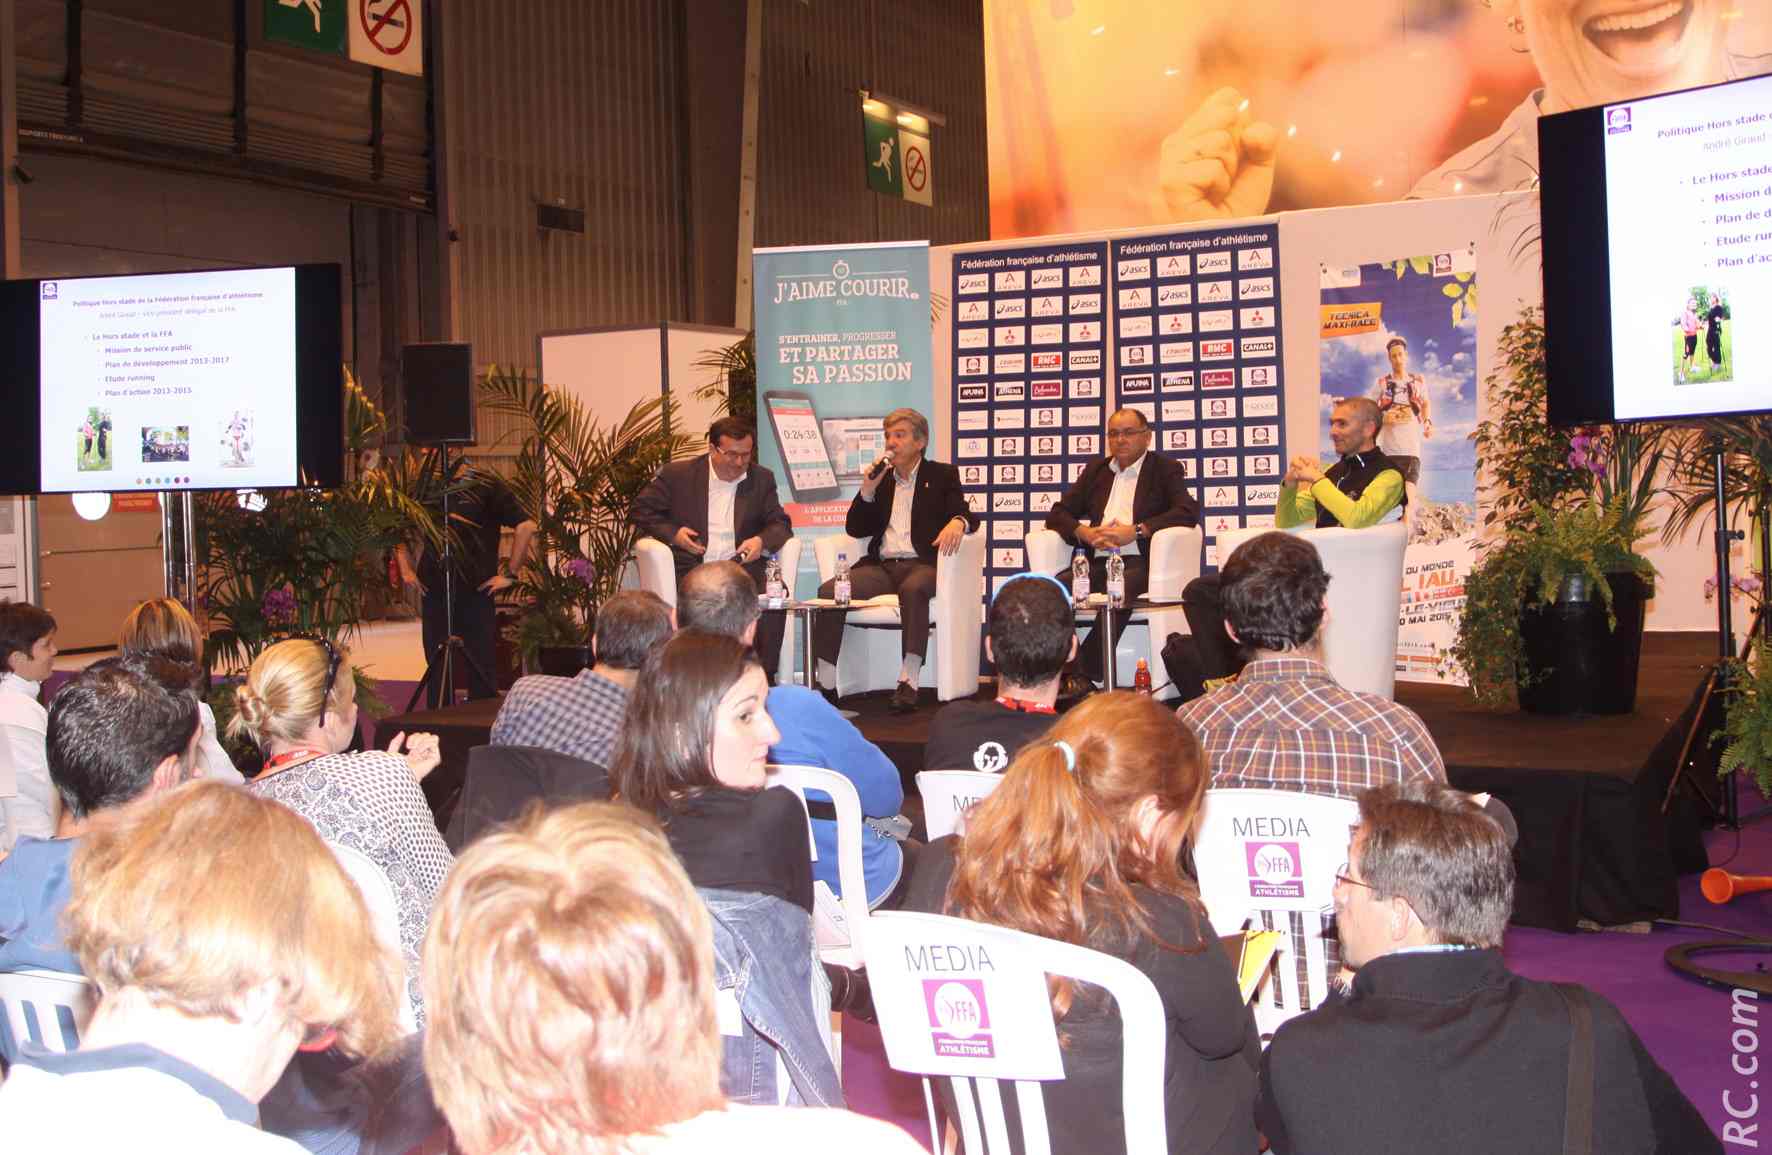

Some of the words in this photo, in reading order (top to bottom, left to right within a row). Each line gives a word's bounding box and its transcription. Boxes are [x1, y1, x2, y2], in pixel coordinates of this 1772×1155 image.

[1657, 124, 1704, 140] Politique
[1707, 119, 1732, 131] Hors
[1735, 111, 1766, 125] stade
[1692, 175, 1706, 186] Le
[1710, 169, 1738, 182] Hors
[1714, 189, 1760, 203] Mission
[1716, 213, 1742, 225] Plan
[1745, 207, 1760, 220] de
[1120, 242, 1167, 256] Fédération
[1169, 237, 1210, 253] française
[1213, 233, 1268, 247] d'athlétisme
[1716, 233, 1751, 247] Etude
[961, 257, 1005, 270] Fédération
[1006, 253, 1044, 268] française
[1046, 250, 1098, 263] d'athlétisme
[1717, 256, 1743, 268] Plan
[773, 280, 837, 305] J'AIME
[779, 347, 802, 365] ET
[804, 343, 900, 363] PARTAGER
[792, 366, 821, 385] SA
[823, 361, 912, 384] PASSION
[1422, 559, 1456, 572] MONDE
[1408, 615, 1426, 624] MAI
[1232, 817, 1311, 837] MEDIA
[904, 944, 995, 972] MEDIA
